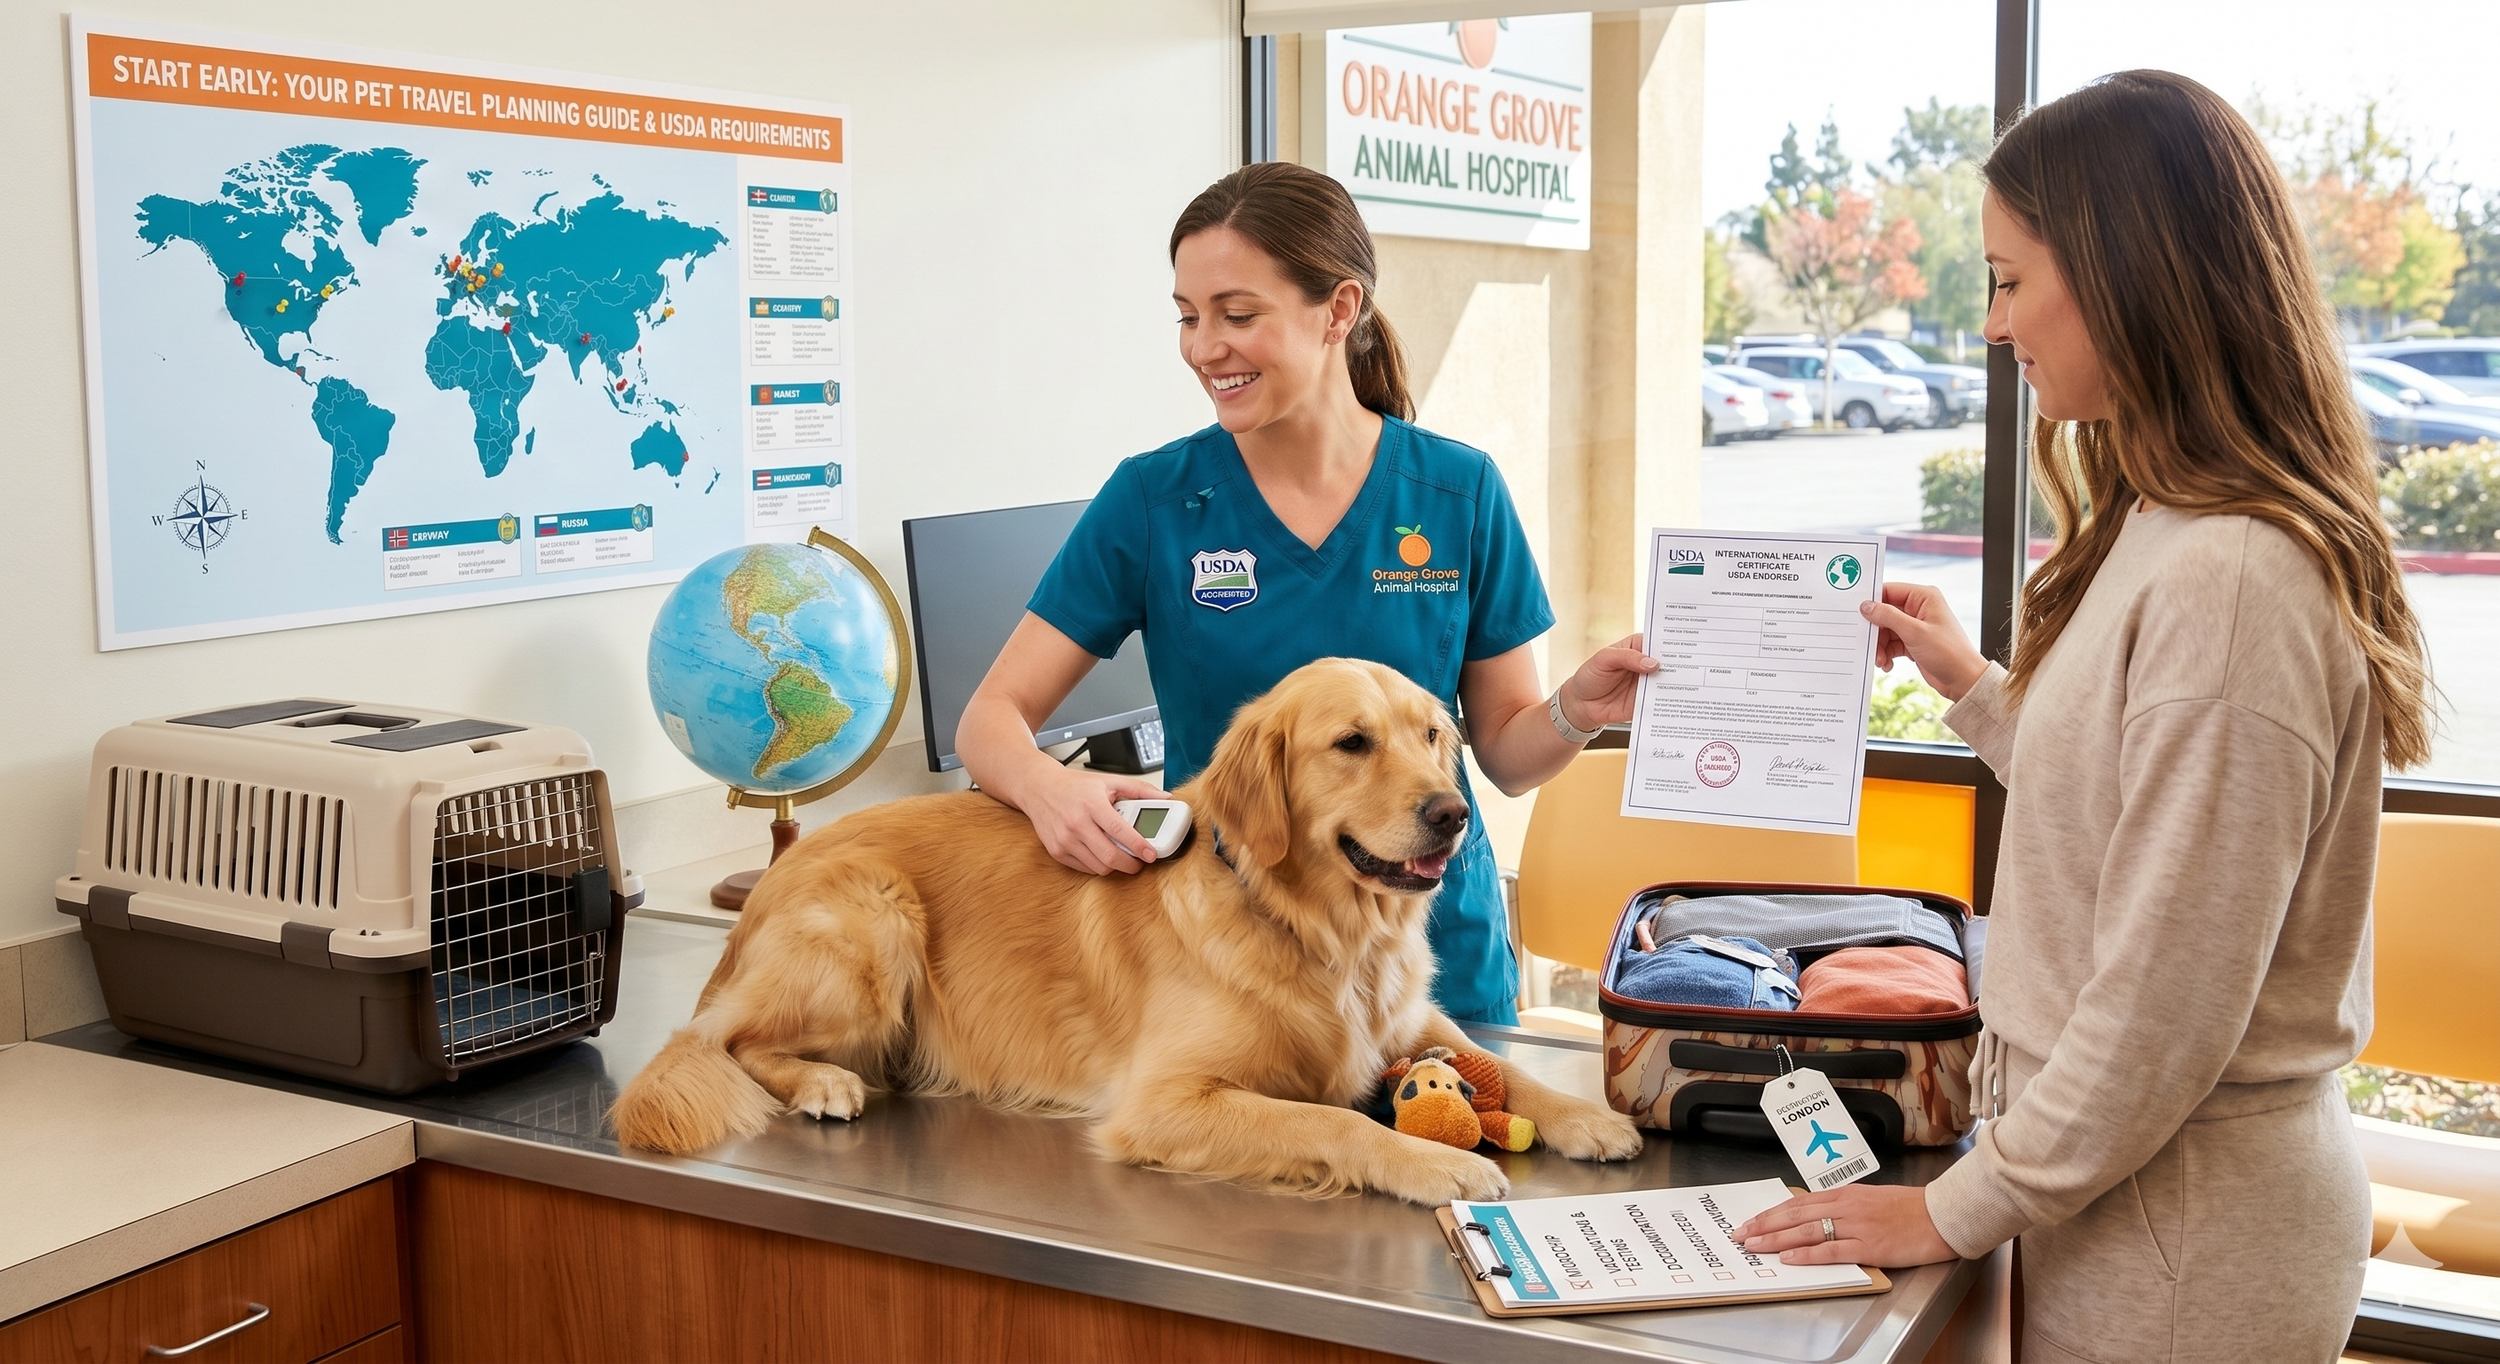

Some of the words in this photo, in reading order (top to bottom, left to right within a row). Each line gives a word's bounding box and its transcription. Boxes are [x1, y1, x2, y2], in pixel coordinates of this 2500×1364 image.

[113, 54, 192, 89] START
[200, 63, 278, 97] EARLY:
[284, 73, 348, 104] YOUR
[354, 80, 393, 108] PET
[399, 84, 477, 116] TRAVEL
[482, 93, 580, 126] PLANNING
[585, 105, 640, 132] GUIDE
[644, 110, 657, 134] &
[660, 112, 707, 139] USDA
[710, 117, 831, 151] REQUIREMENTS
[1342, 60, 1480, 136] ORANGE
[1490, 91, 1583, 152] GROVE
[1354, 134, 1458, 189] ANIMAL
[1467, 151, 1576, 203] HOSPITAL
[196, 460, 206, 470] N
[152, 515, 164, 526] W
[241, 509, 248, 520] E
[561, 518, 589, 529] RUSSIA
[1669, 549, 1705, 562] USDA
[1715, 550, 1780, 560] INTERNATIONAL
[1782, 552, 1815, 561] HEALTH
[202, 563, 208, 574] S
[1201, 560, 1248, 574] USDA
[1737, 562, 1790, 570] CERTIFICATE
[1372, 569, 1419, 582] Orange
[1421, 568, 1460, 580] Grove
[1728, 571, 1752, 580] USDA
[1752, 572, 1800, 582] ENDORSED
[1374, 582, 1412, 594] Animal
[1414, 580, 1459, 595] Hospital
[1782, 1098, 1831, 1126] LONDON
